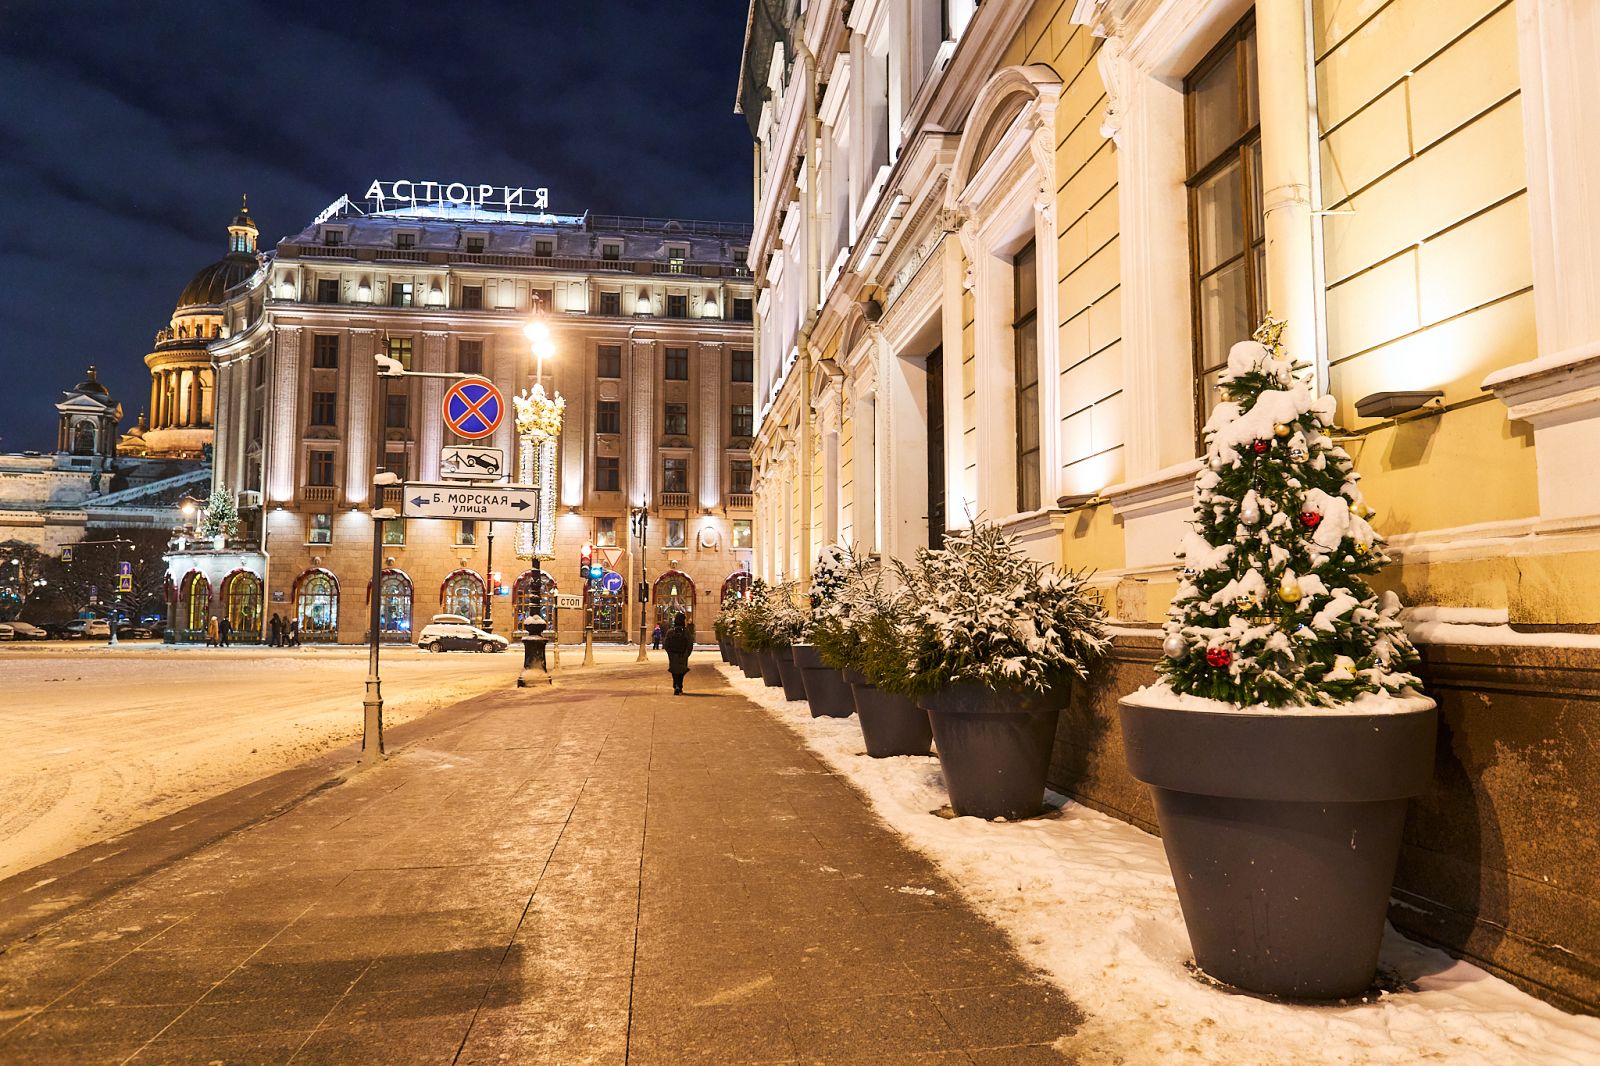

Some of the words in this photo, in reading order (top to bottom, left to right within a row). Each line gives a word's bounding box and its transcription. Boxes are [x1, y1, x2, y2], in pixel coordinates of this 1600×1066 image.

[365, 179, 548, 208] АСТОРИЯ
[433, 493, 444, 503] Б.
[448, 494, 508, 505] МОРСКАЯ
[452, 505, 488, 514] улица
[560, 598, 580, 607] СТОП
